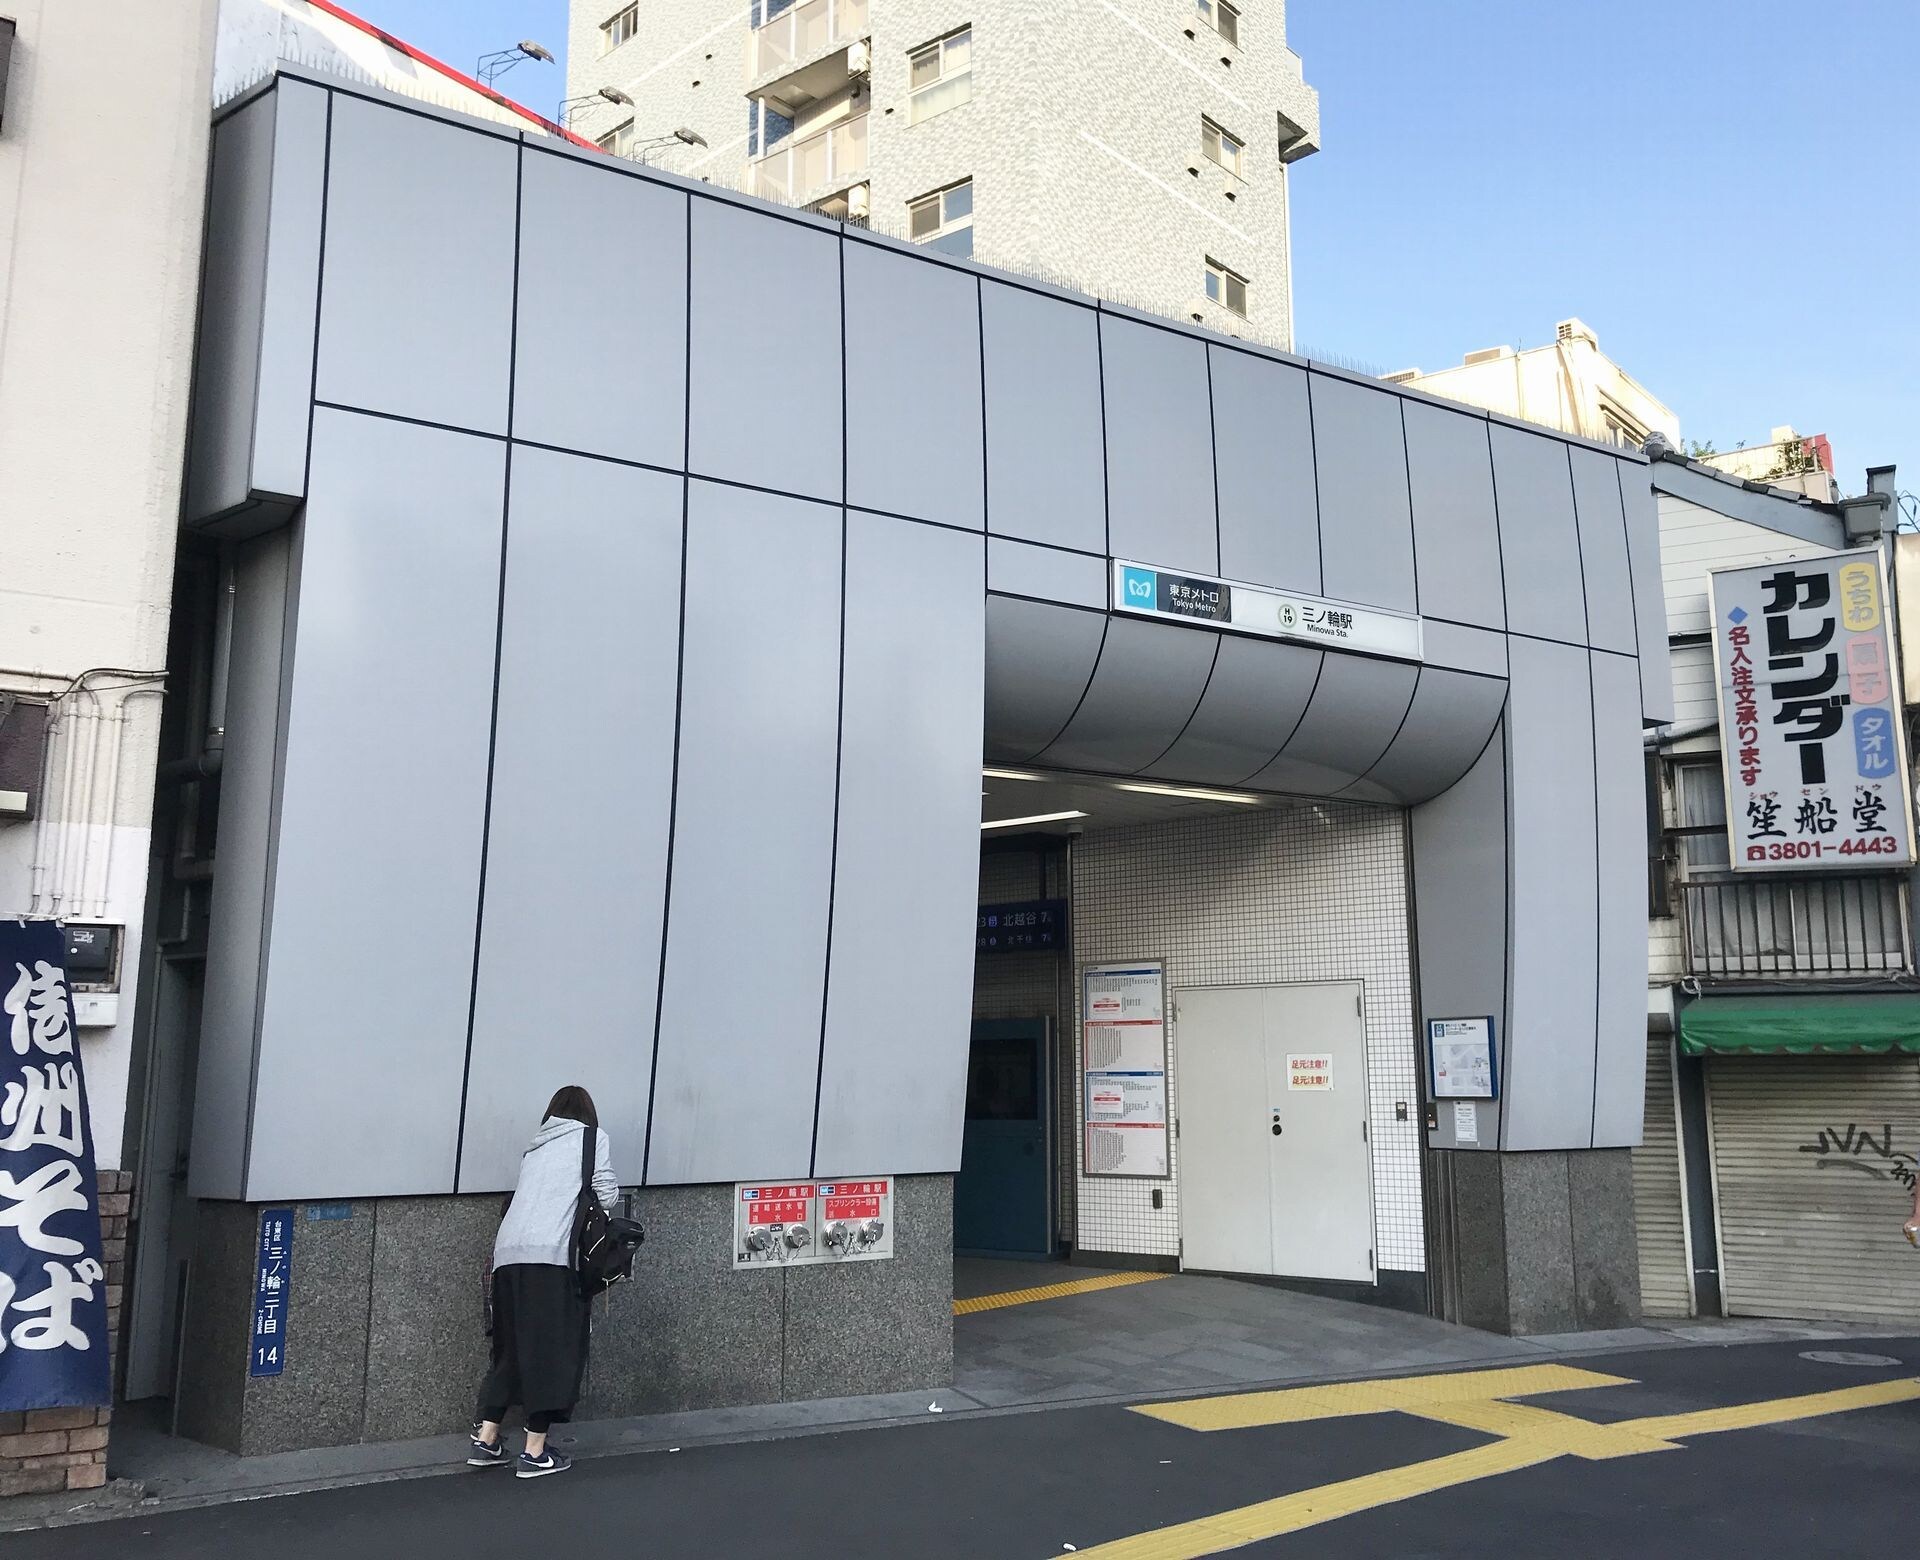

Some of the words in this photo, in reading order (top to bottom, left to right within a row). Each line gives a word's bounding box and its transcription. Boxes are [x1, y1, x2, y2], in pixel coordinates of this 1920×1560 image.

[1169, 583, 1219, 603] 東京メトロ
[1846, 571, 1875, 624] うちわ
[1172, 597, 1194, 610] Tokyo
[1195, 601, 1217, 613] Metro
[1284, 607, 1291, 616] H
[1283, 615, 1293, 624] 19
[1302, 606, 1353, 630] 三ノ輪駅
[1306, 624, 1335, 636] Minowa
[1335, 628, 1349, 638] Sta.
[1761, 571, 1850, 784] カレンダー
[1728, 625, 1762, 787] 名入注文承ります
[1860, 717, 1890, 770] タオル
[1768, 836, 1898, 860] 3801-4443
[0, 959, 104, 1353] 信州そば
[765, 1187, 809, 1199] 三ノ輪駅
[840, 1183, 882, 1194] 三ノ輪駅
[264, 1246, 283, 1334] 三ノ輪二丁目
[258, 1346, 278, 1366] 14
